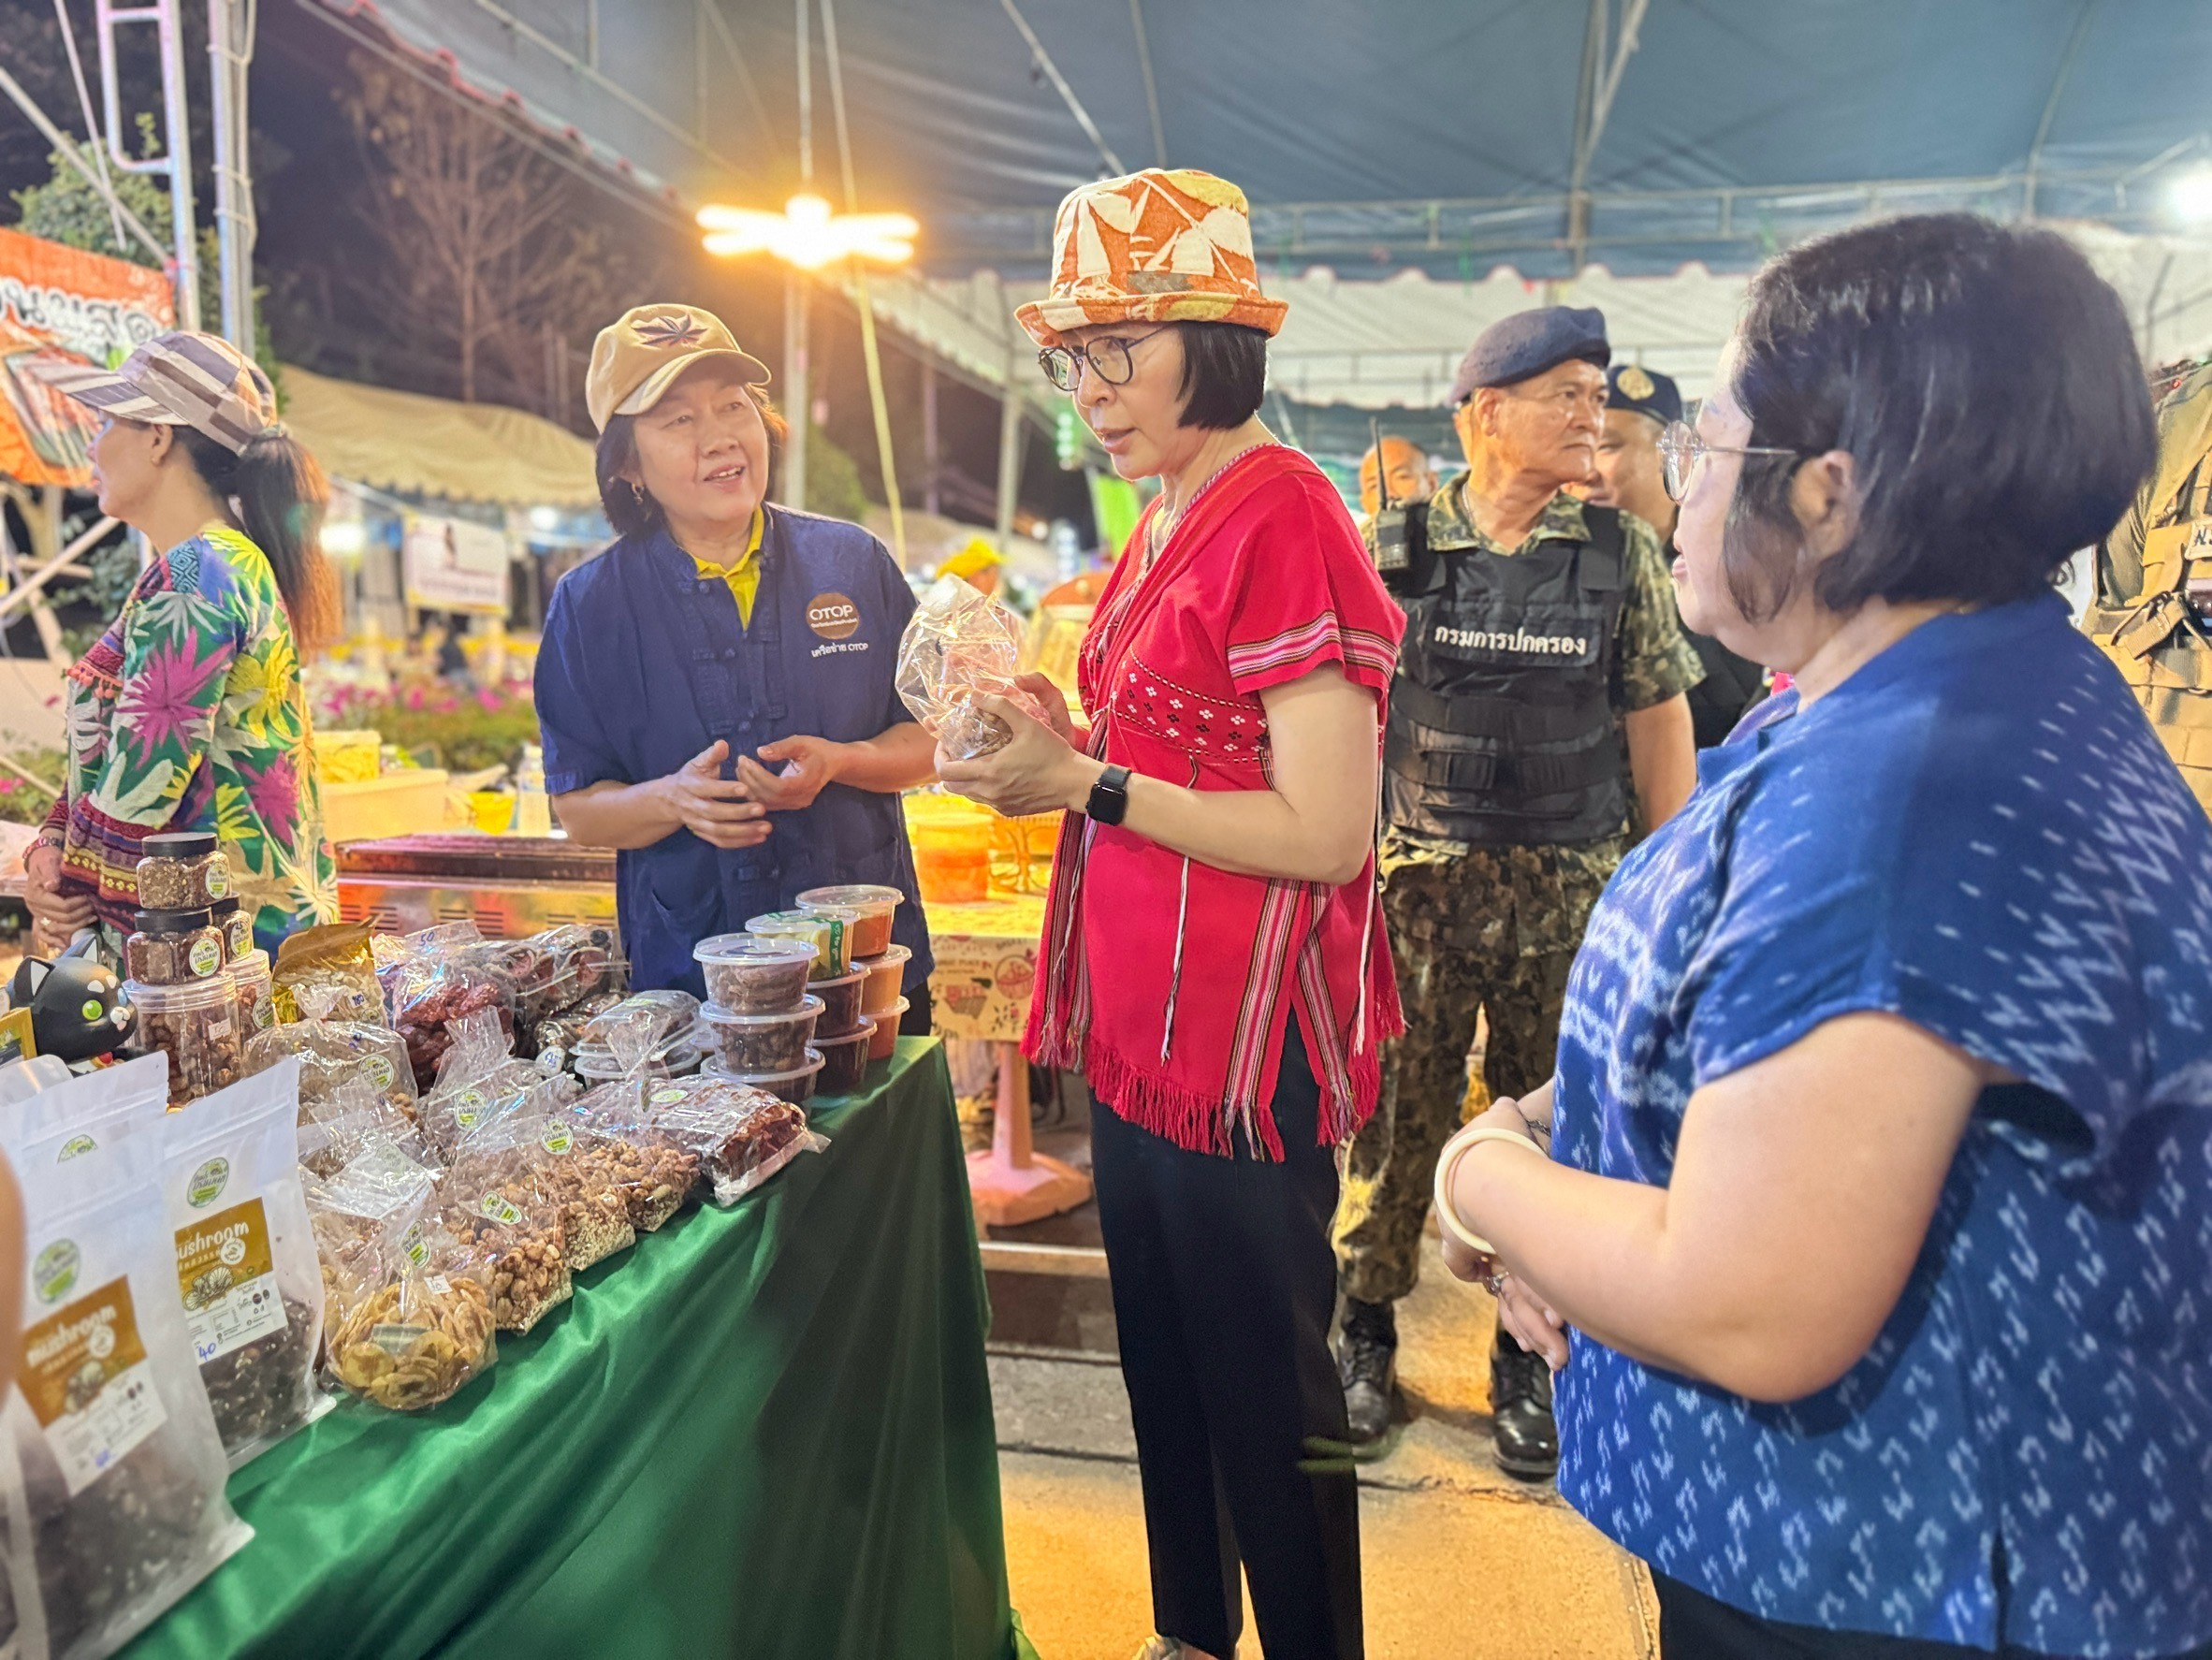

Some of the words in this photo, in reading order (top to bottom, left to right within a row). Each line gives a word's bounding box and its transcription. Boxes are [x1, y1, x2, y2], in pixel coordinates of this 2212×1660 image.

[809, 604, 853, 620] OTOP
[1434, 626, 1587, 655] กรมการปกครอง
[811, 642, 847, 657] เครือข่าย
[848, 643, 868, 651] OTOP
[419, 931, 434, 946] 50
[178, 1221, 249, 1260] ushroom
[198, 1342, 217, 1361] 40
